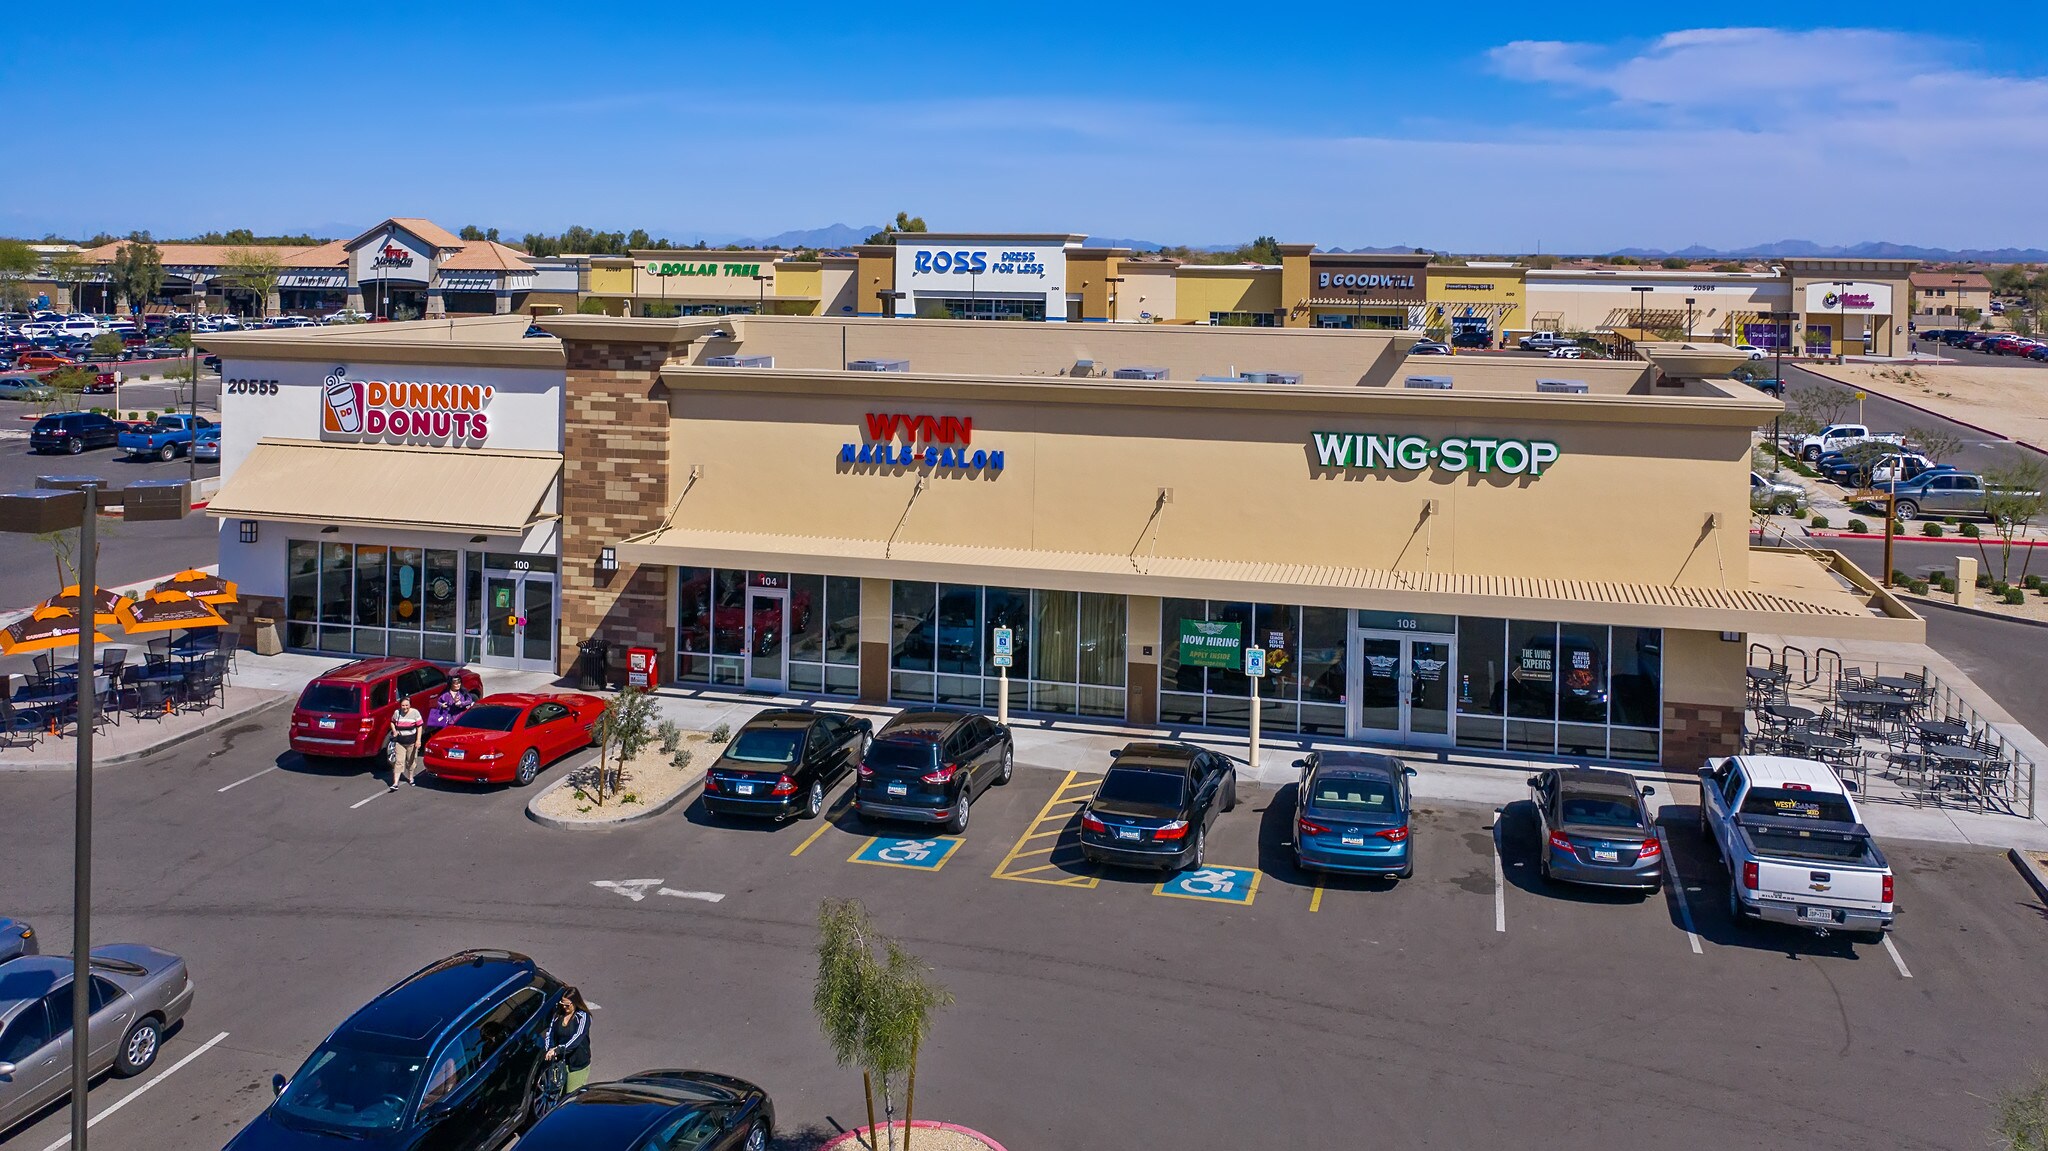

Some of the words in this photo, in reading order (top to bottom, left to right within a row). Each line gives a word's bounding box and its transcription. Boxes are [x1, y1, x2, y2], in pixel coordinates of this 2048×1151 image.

[1001, 251, 1035, 262] DRESS
[914, 251, 987, 274] ROSS
[661, 262, 718, 276] DOLLAR
[723, 263, 760, 277] TREE
[991, 263, 1015, 274] FOR
[1017, 263, 1044, 274] LESS
[1333, 273, 1415, 287] GOODWILL
[1763, 331, 1787, 339] Belog!
[228, 378, 279, 396] 20555
[367, 382, 493, 410] DUNKIN'
[340, 407, 352, 418] DD
[366, 409, 488, 439] DONUTS
[865, 413, 972, 444] WYNN
[514, 561, 529, 569] 100
[761, 577, 777, 586] 104
[1397, 619, 1416, 629] 108
[1182, 634, 1205, 646] NOW
[1206, 636, 1240, 648] HIRING
[1189, 651, 1208, 659] APPLY
[1522, 648, 1533, 658] THE
[1534, 649, 1551, 660] WING
[1523, 659, 1551, 670] EXPERTS
[1774, 800, 1791, 808] WEST
